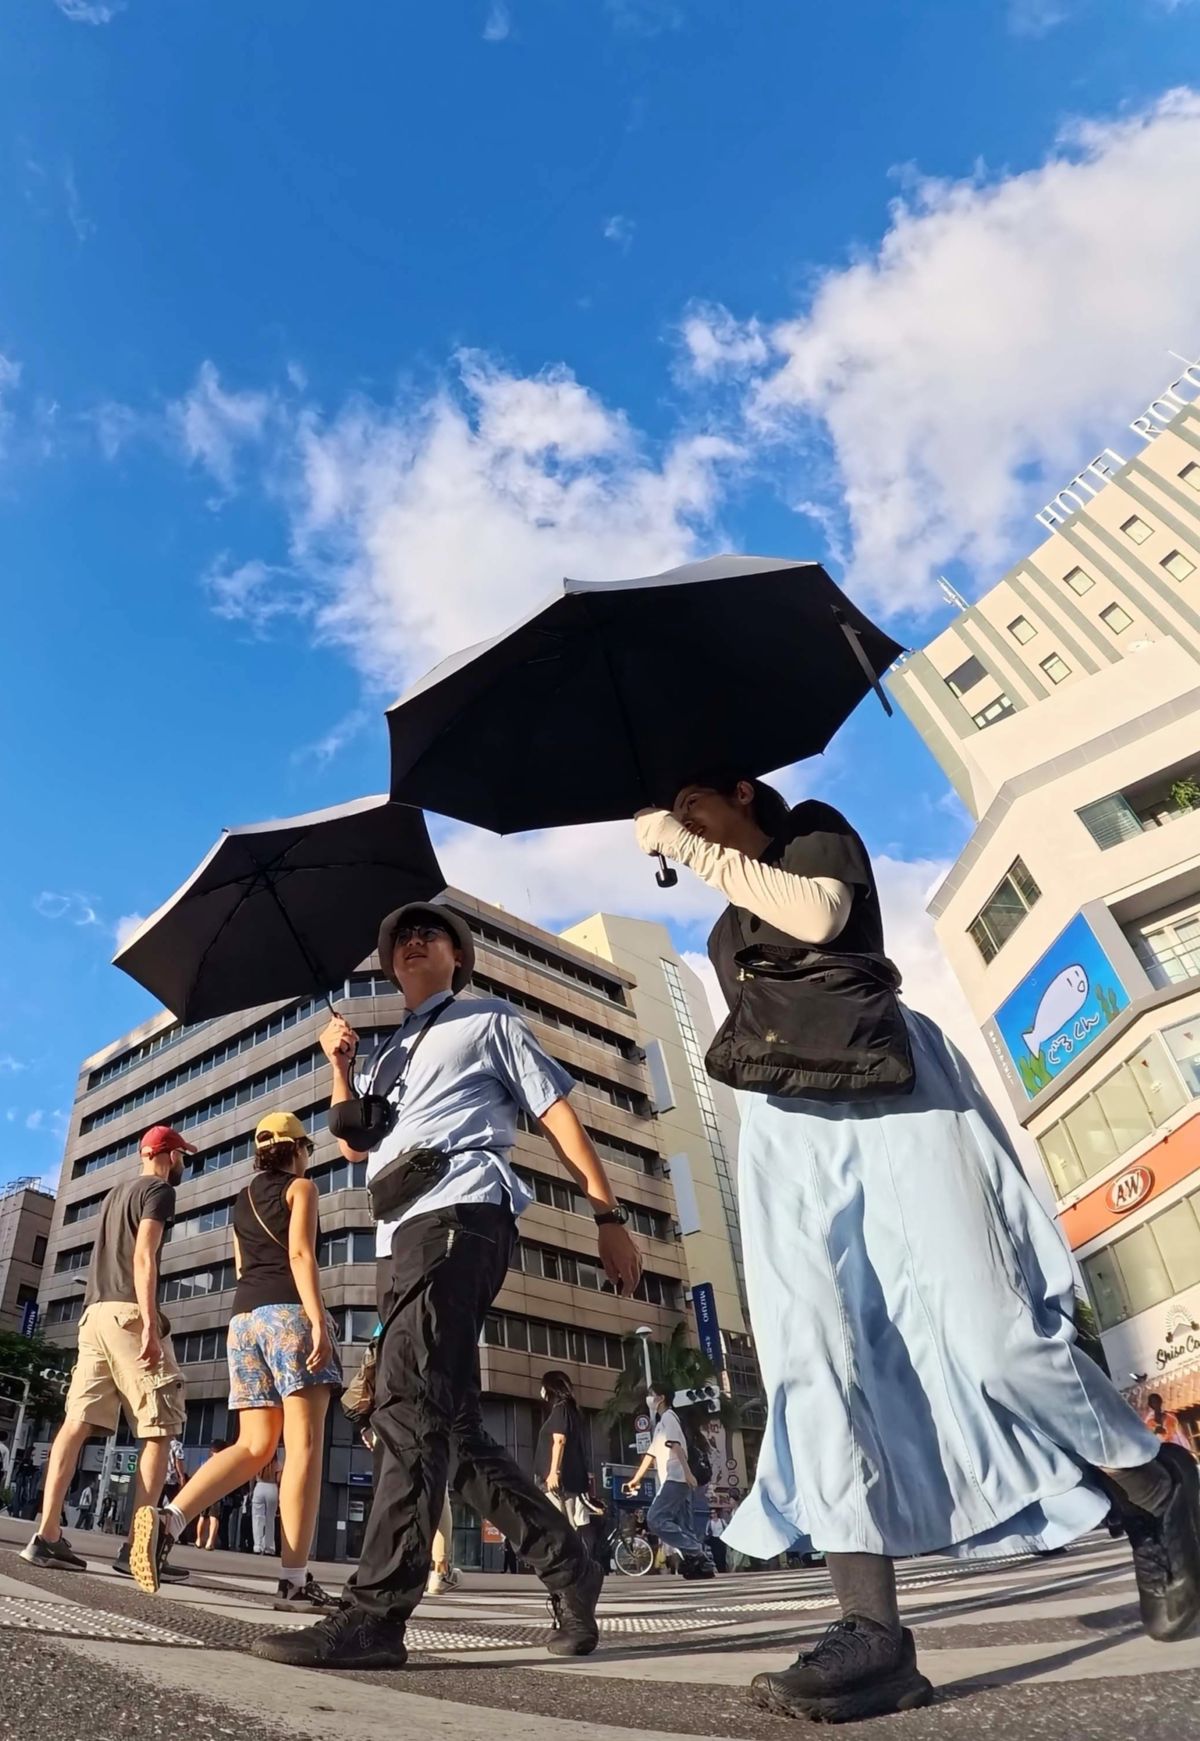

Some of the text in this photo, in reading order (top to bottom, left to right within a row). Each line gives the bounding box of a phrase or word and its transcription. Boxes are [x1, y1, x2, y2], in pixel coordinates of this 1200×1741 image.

[1036, 448, 1127, 533] HOTEL
[1047, 1012, 1099, 1064] ぐるくん
